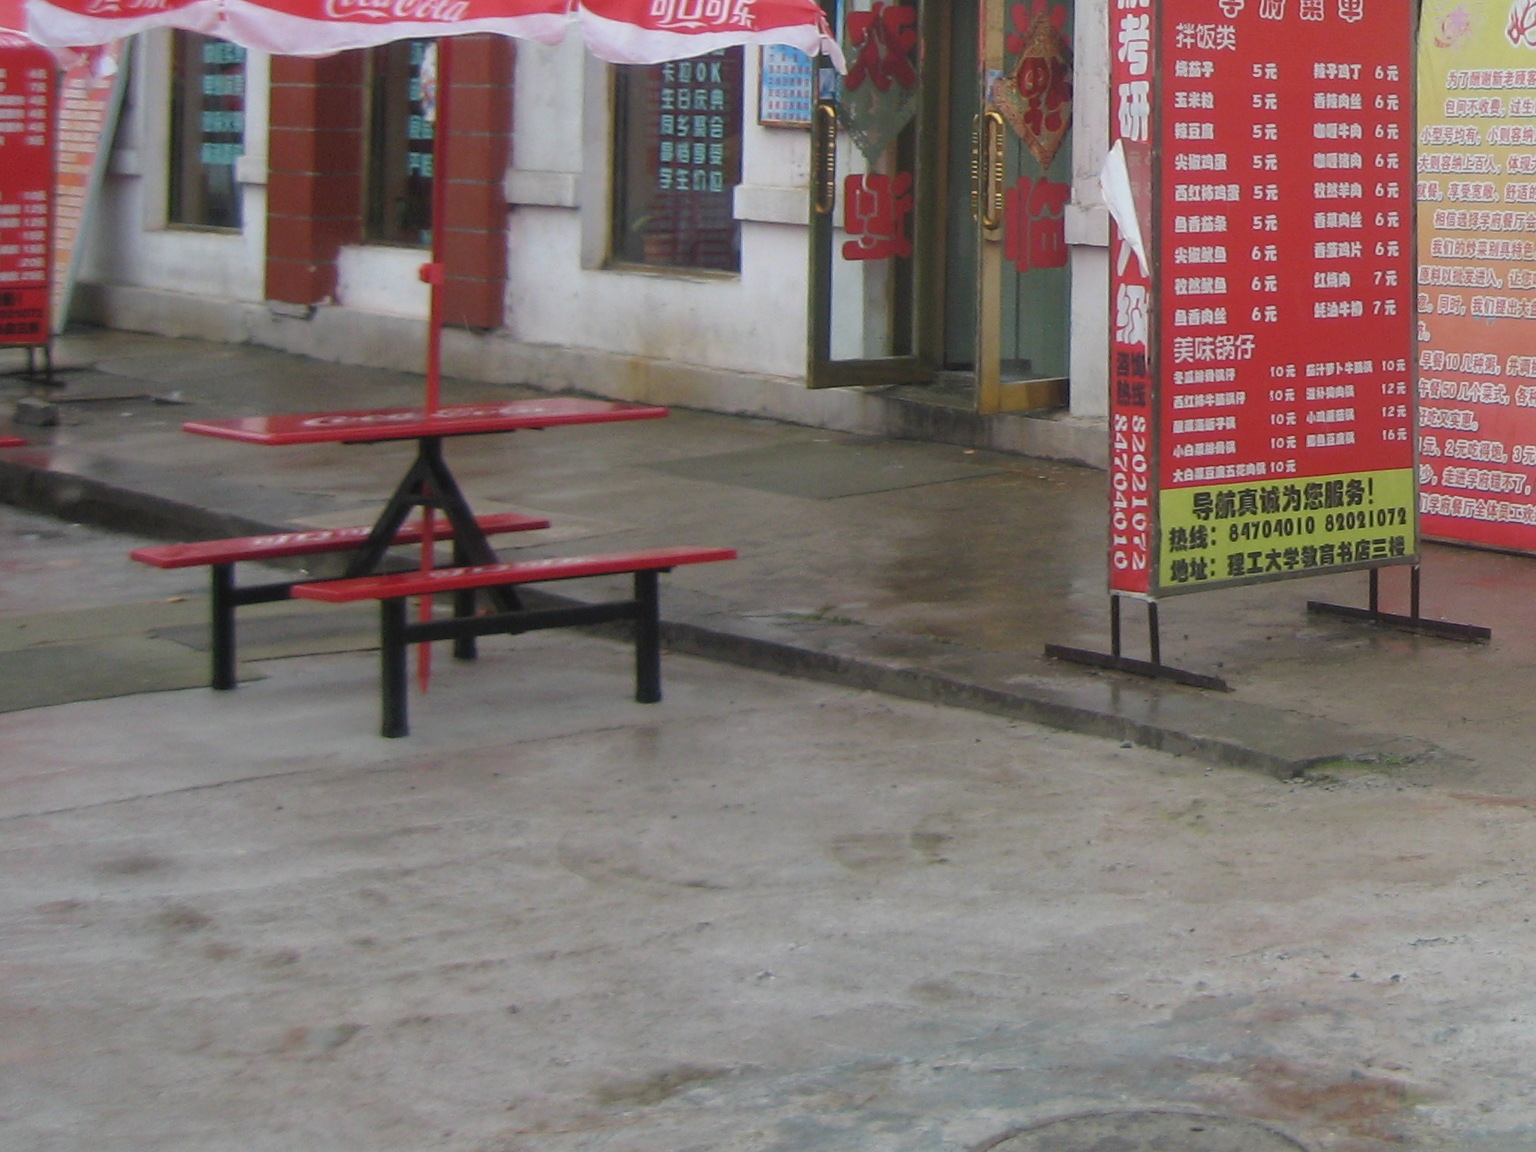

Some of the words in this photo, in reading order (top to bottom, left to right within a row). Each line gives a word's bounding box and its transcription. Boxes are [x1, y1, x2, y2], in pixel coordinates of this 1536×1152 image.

[1175, 22, 1236, 50] 拌饭类
[1252, 63, 1278, 80] 5元
[1375, 65, 1399, 81] 6元
[1174, 91, 1214, 109] 玉米粒
[1252, 93, 1278, 110] 5元
[1375, 95, 1399, 110] 6元
[1252, 124, 1278, 140] 5元
[1375, 124, 1399, 140] 6元
[1252, 153, 1278, 171] 5元
[1375, 152, 1399, 169] 6元
[1174, 184, 1240, 202] 西红柿鸡蛋
[1252, 184, 1279, 201] 5元
[1375, 182, 1399, 198] 6元
[1252, 214, 1279, 231] 5元
[1375, 212, 1399, 228] 6元
[1251, 245, 1278, 262] 6元
[1375, 241, 1399, 257] 6元
[1251, 275, 1278, 292] 6元
[1313, 271, 1351, 289] 红烧肉
[1373, 270, 1398, 287] 7元
[1174, 307, 1227, 327] 鱼香肉丝
[1251, 305, 1278, 323] 6元
[1372, 300, 1397, 316] 7元
[1173, 334, 1256, 363] 美味锅仔
[1270, 364, 1296, 378] 10元
[1382, 358, 1406, 372] 10元
[1270, 388, 1295, 401] 10元
[1381, 381, 1406, 395] 12元
[1270, 412, 1296, 425] 10元
[1382, 404, 1407, 418] 12元
[1270, 435, 1296, 449] 10元
[1382, 427, 1407, 441] 16元
[1270, 459, 1296, 473] 10元
[1192, 477, 1374, 521] 导航真诚为您服务!
[1229, 516, 1315, 542] 84704010
[1325, 507, 1407, 532] 82021072
